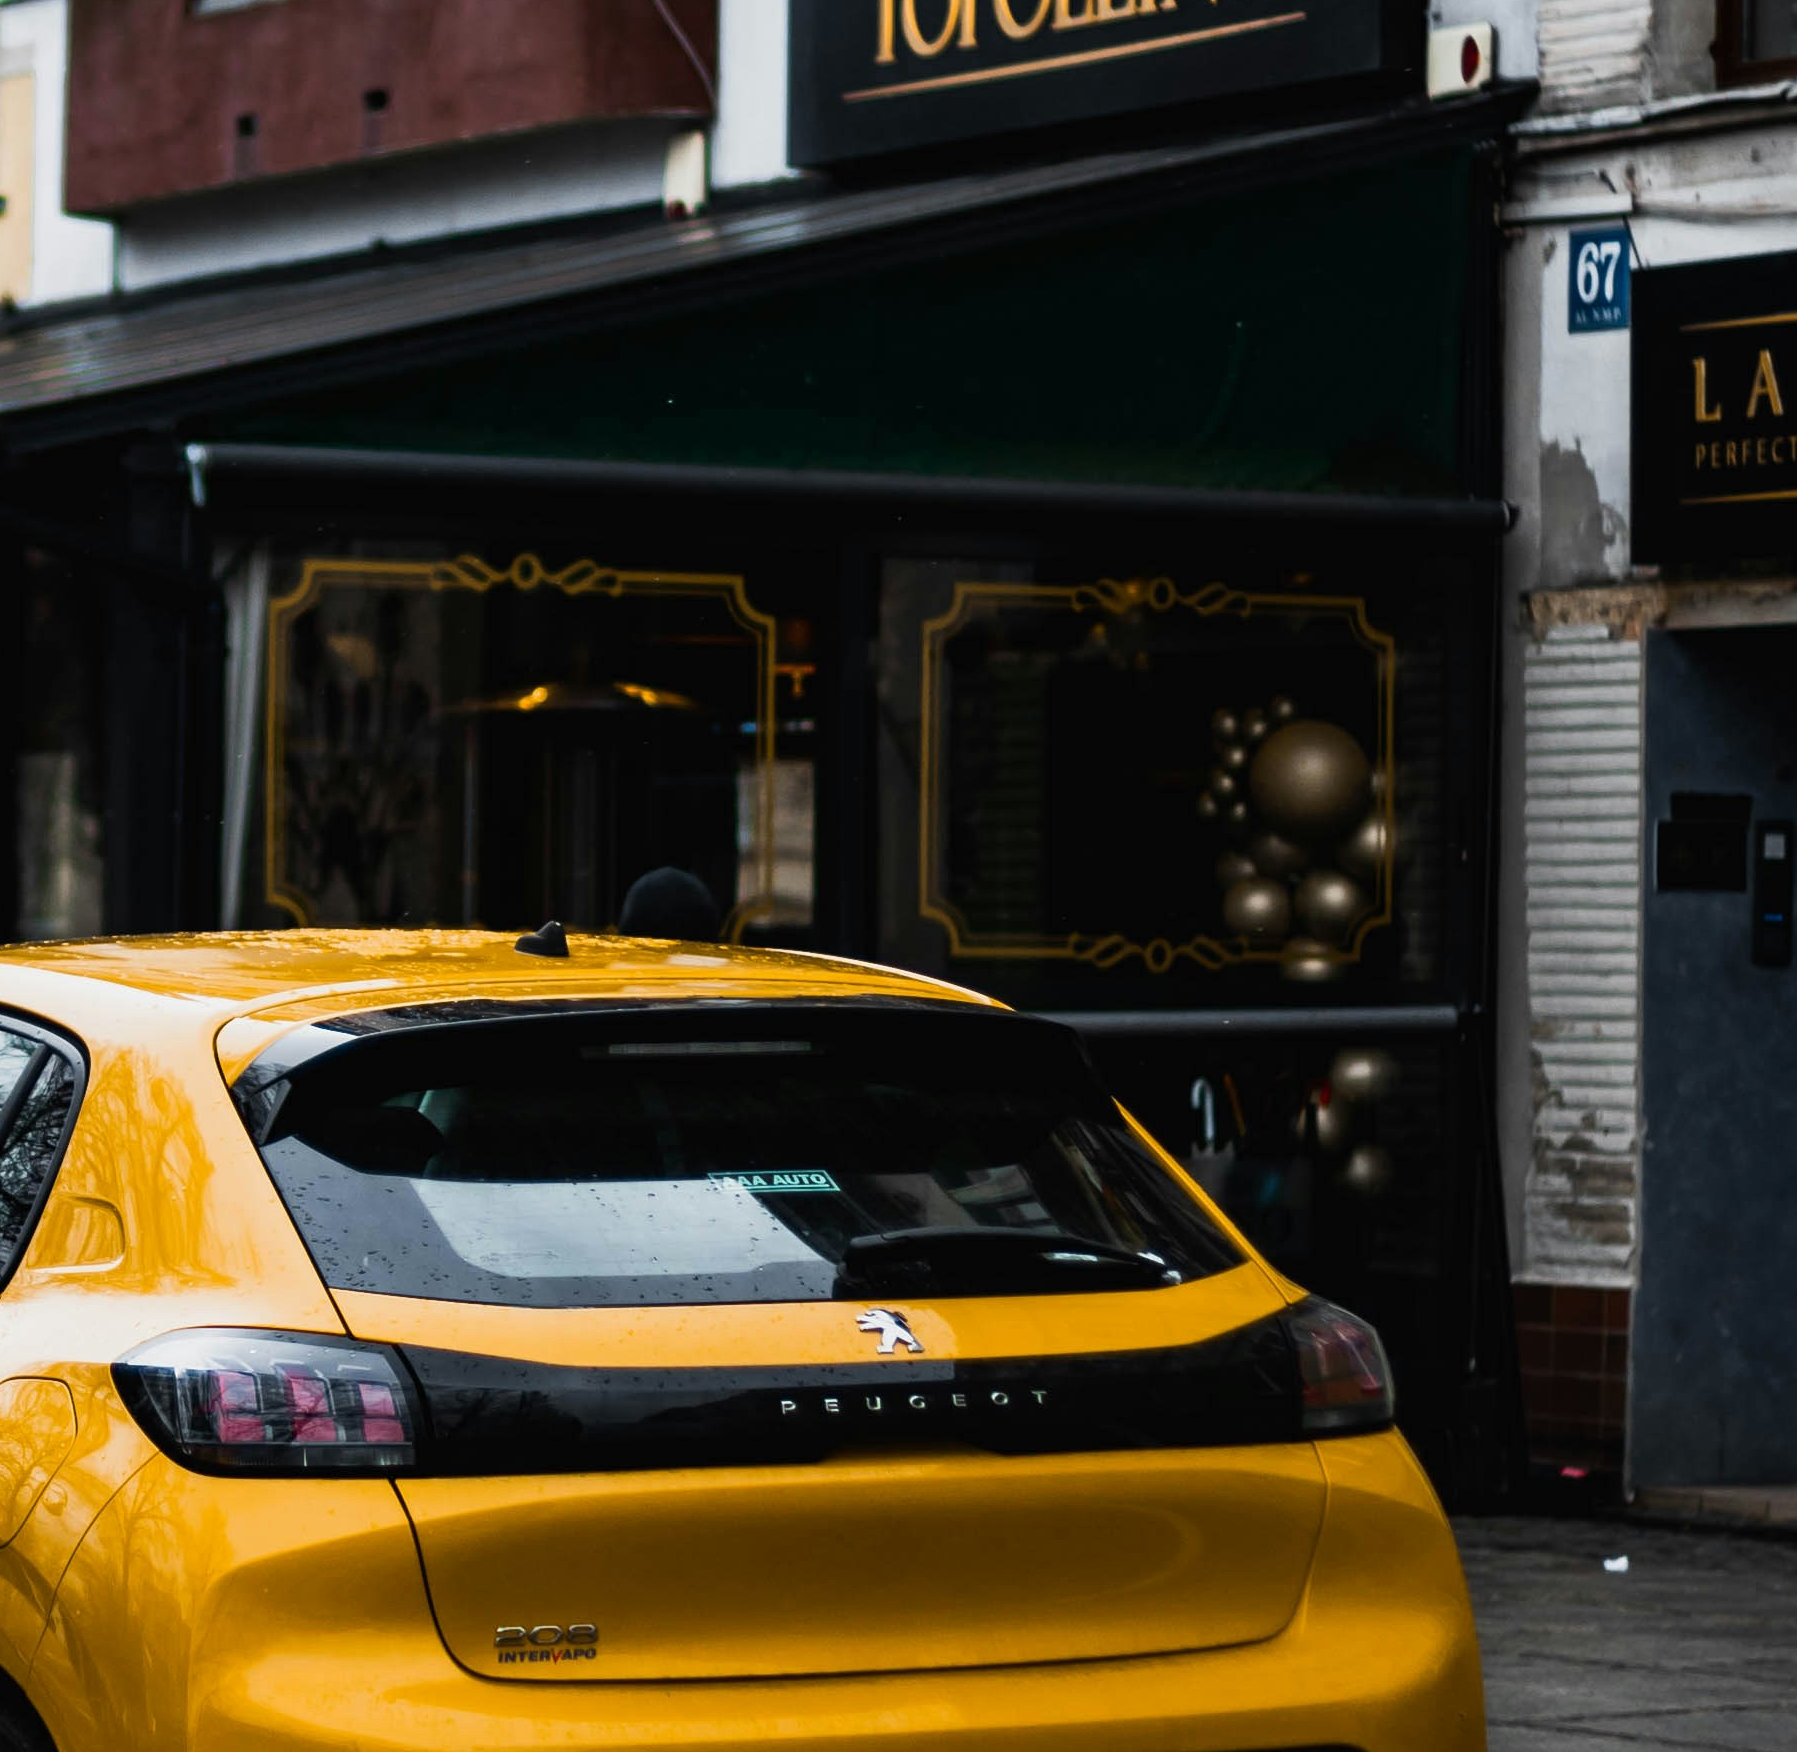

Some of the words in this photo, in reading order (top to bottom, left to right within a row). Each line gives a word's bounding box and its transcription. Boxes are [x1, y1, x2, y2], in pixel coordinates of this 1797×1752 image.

[1577, 241, 1621, 303] 67
[773, 1174, 827, 1185] AUTO
[781, 1390, 1048, 1414] PEUGEOT
[495, 1624, 598, 1647] 208
